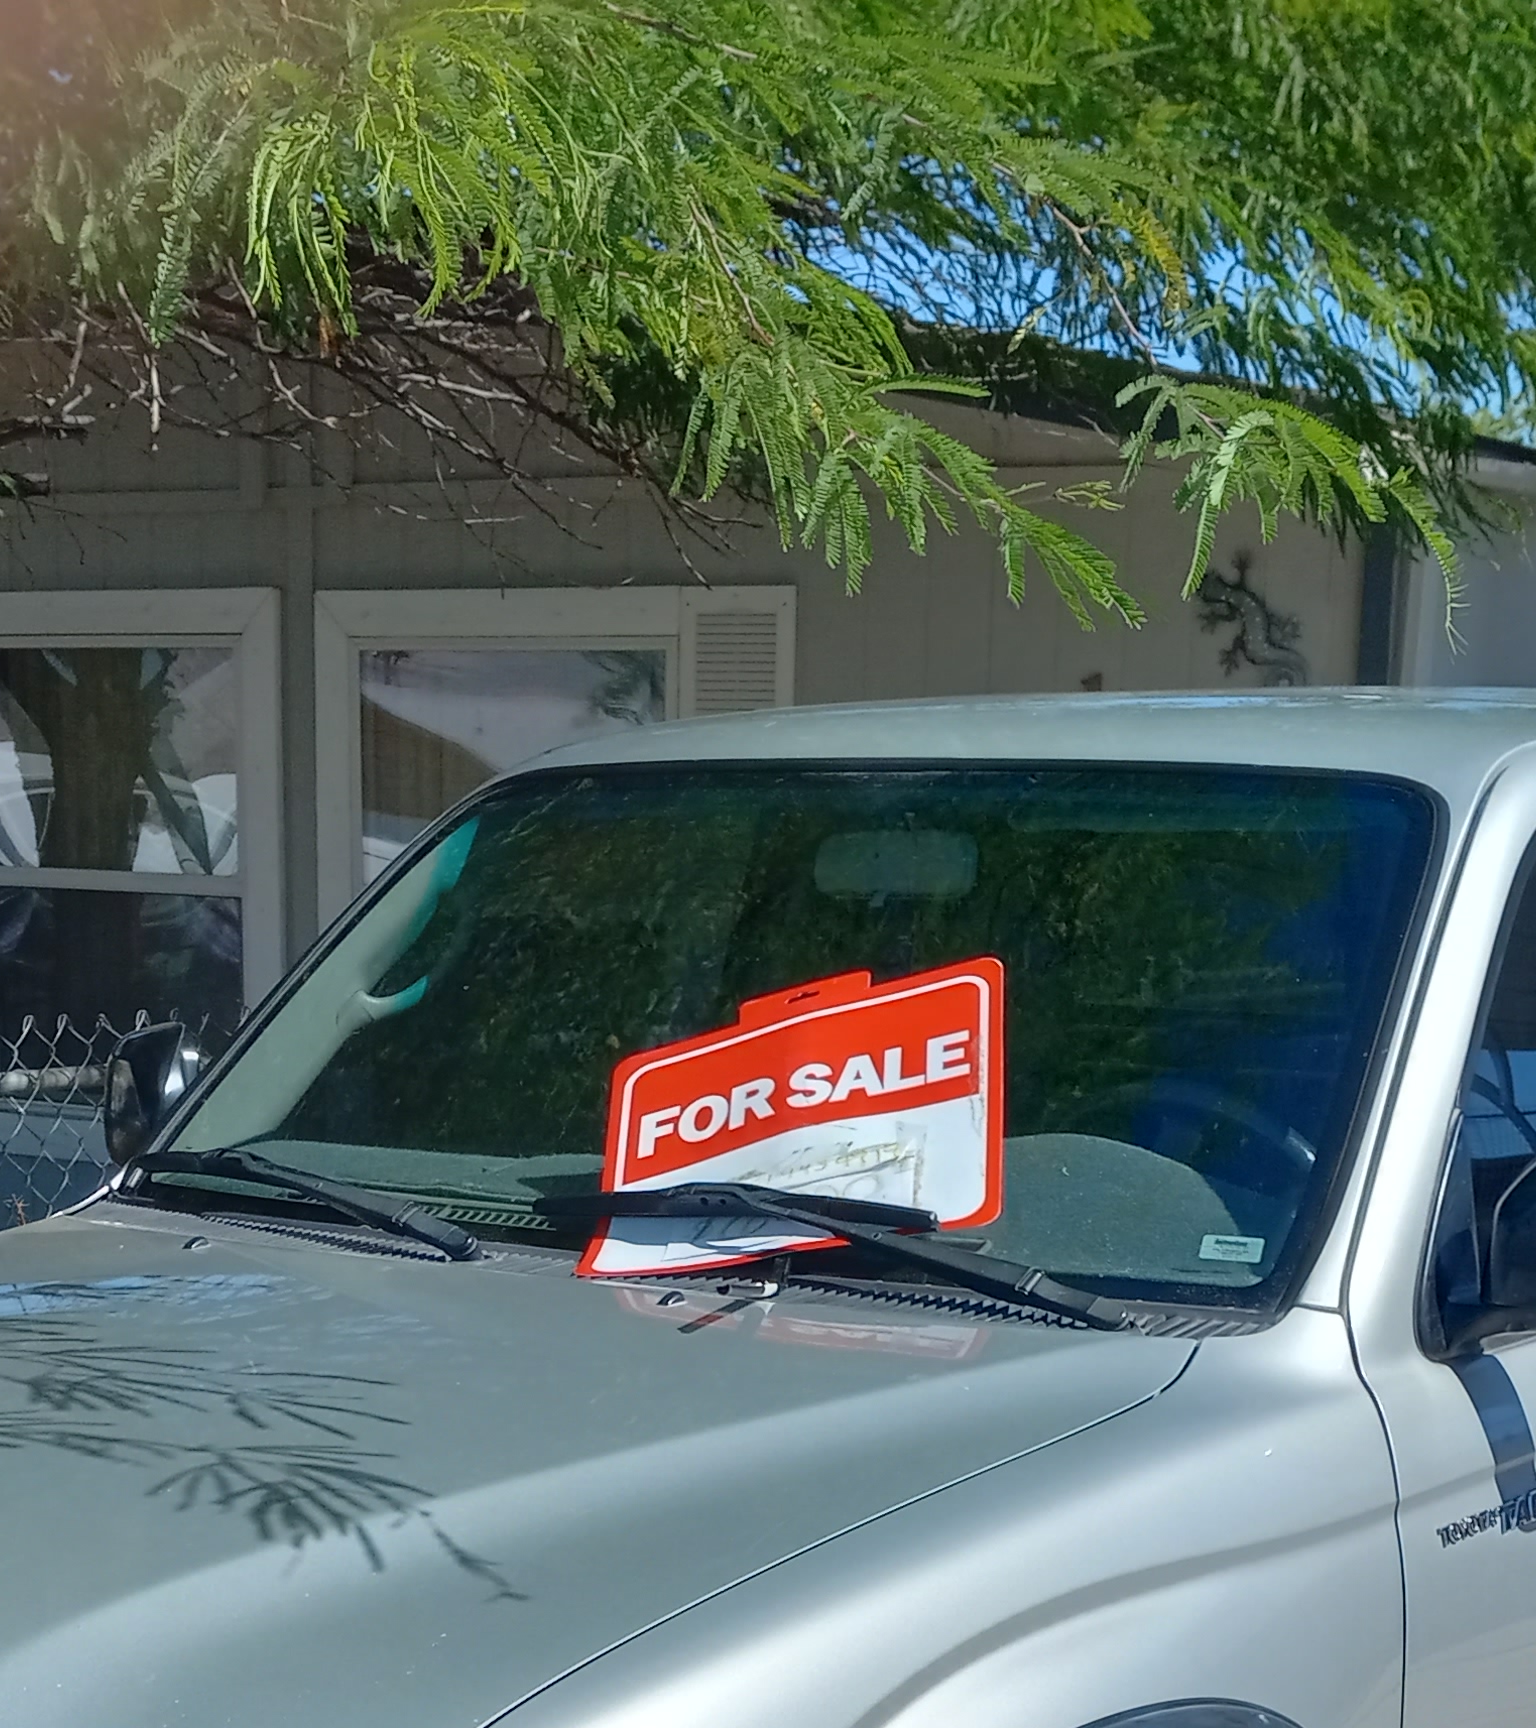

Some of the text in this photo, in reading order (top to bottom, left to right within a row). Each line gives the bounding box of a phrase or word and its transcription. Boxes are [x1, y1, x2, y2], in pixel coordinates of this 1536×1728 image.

[637, 1029, 970, 1159] FOR SALE
[1436, 1506, 1500, 1549] TOYOTA
